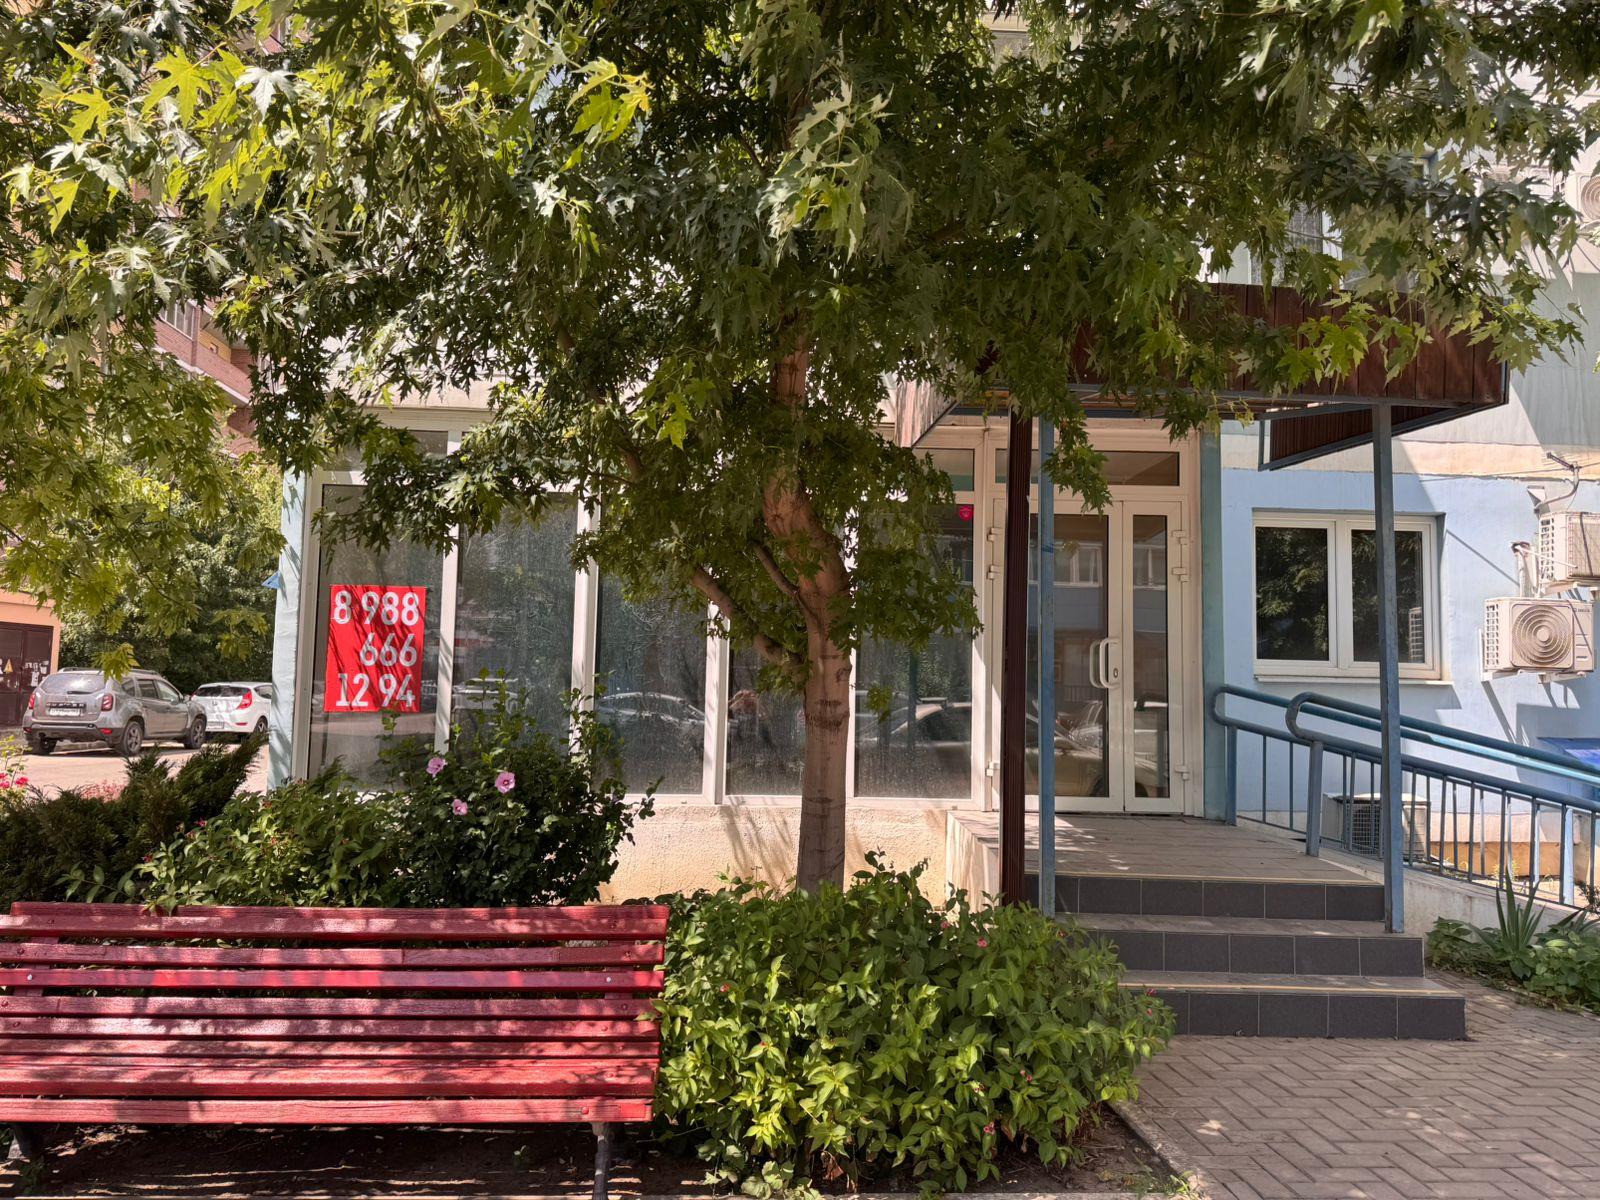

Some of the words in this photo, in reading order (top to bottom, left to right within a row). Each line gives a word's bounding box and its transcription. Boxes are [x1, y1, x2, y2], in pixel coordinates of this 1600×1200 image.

[333, 590, 352, 625] 8
[361, 591, 419, 626] 988
[359, 632, 418, 667] 666
[335, 673, 370, 707] 12
[378, 673, 416, 707] 94
